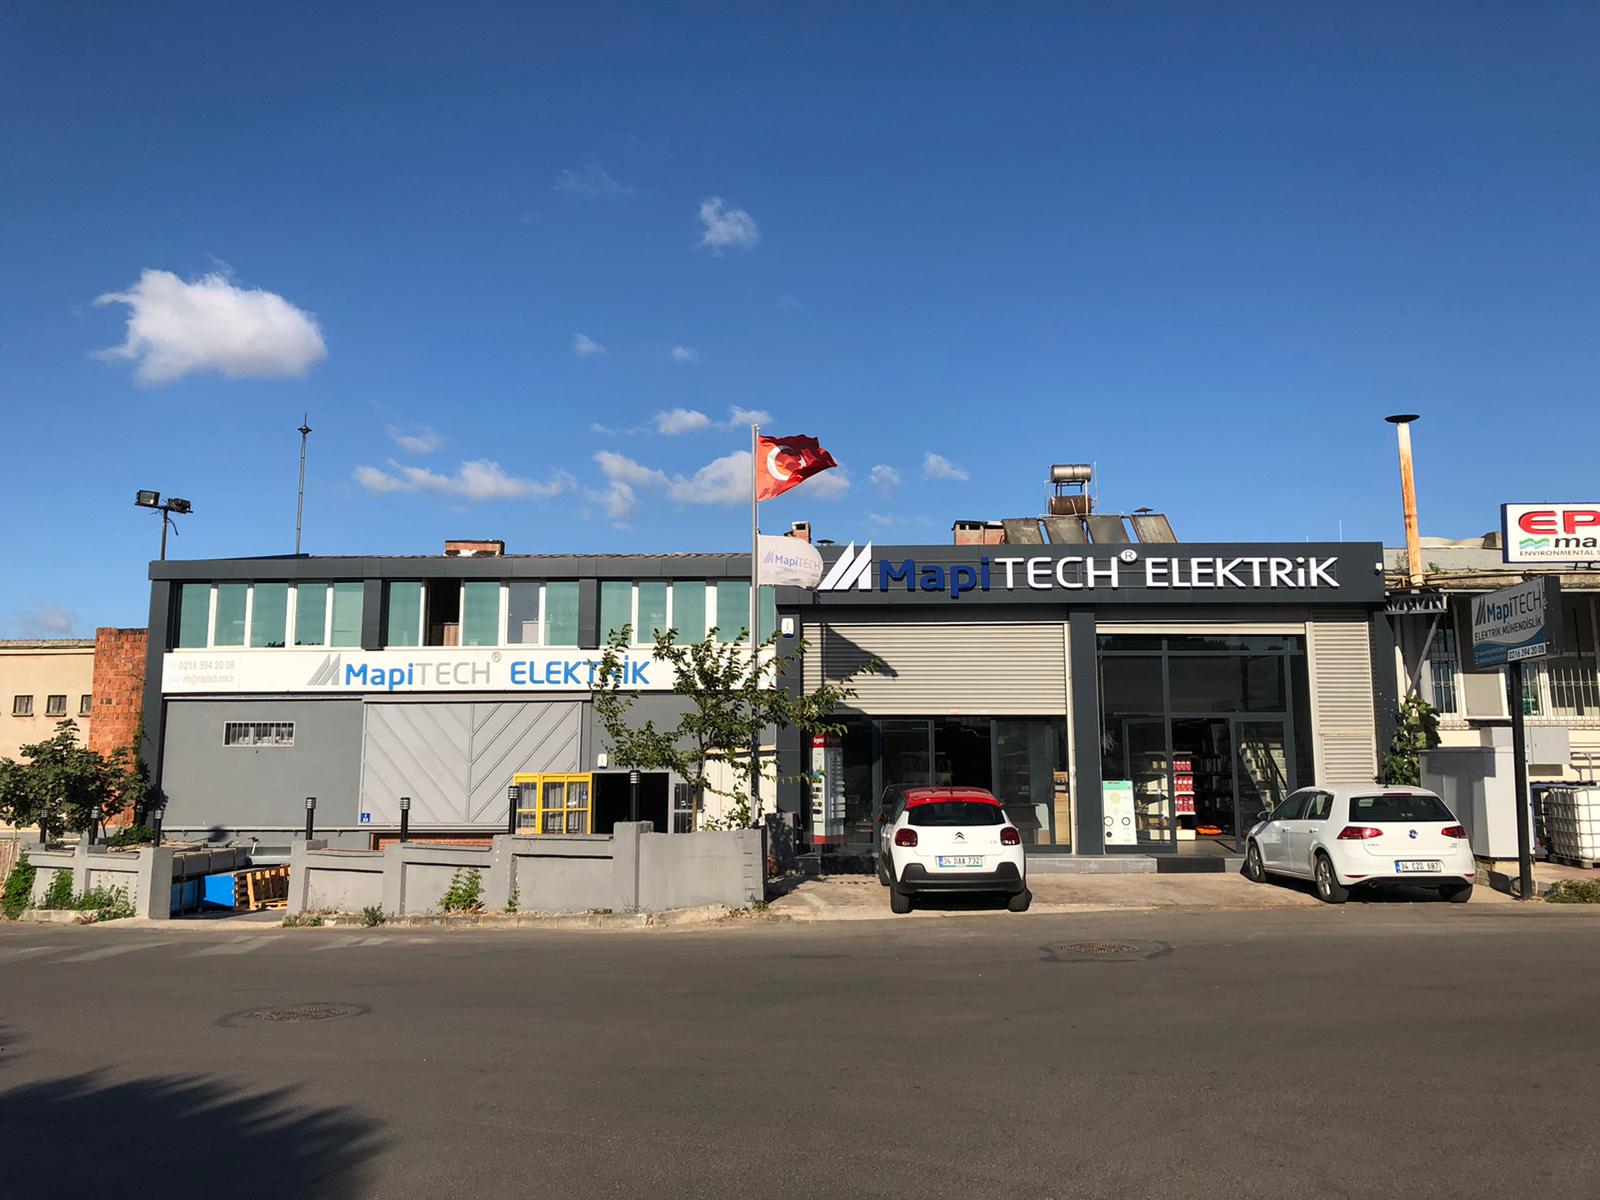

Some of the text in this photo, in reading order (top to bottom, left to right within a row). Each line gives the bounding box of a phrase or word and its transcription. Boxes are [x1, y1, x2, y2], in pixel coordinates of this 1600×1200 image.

[775, 554, 820, 571] MapiTECH
[1486, 589, 1541, 624] MapiTECH
[1502, 615, 1542, 636] MÜHENDİSLİK
[1509, 649, 1520, 660] 0216
[1531, 645, 1537, 655] 20
[178, 660, 198, 671] 0216
[214, 660, 224, 670] 20
[510, 655, 650, 685] ELEKTİK
[1401, 862, 1409, 870] 34
